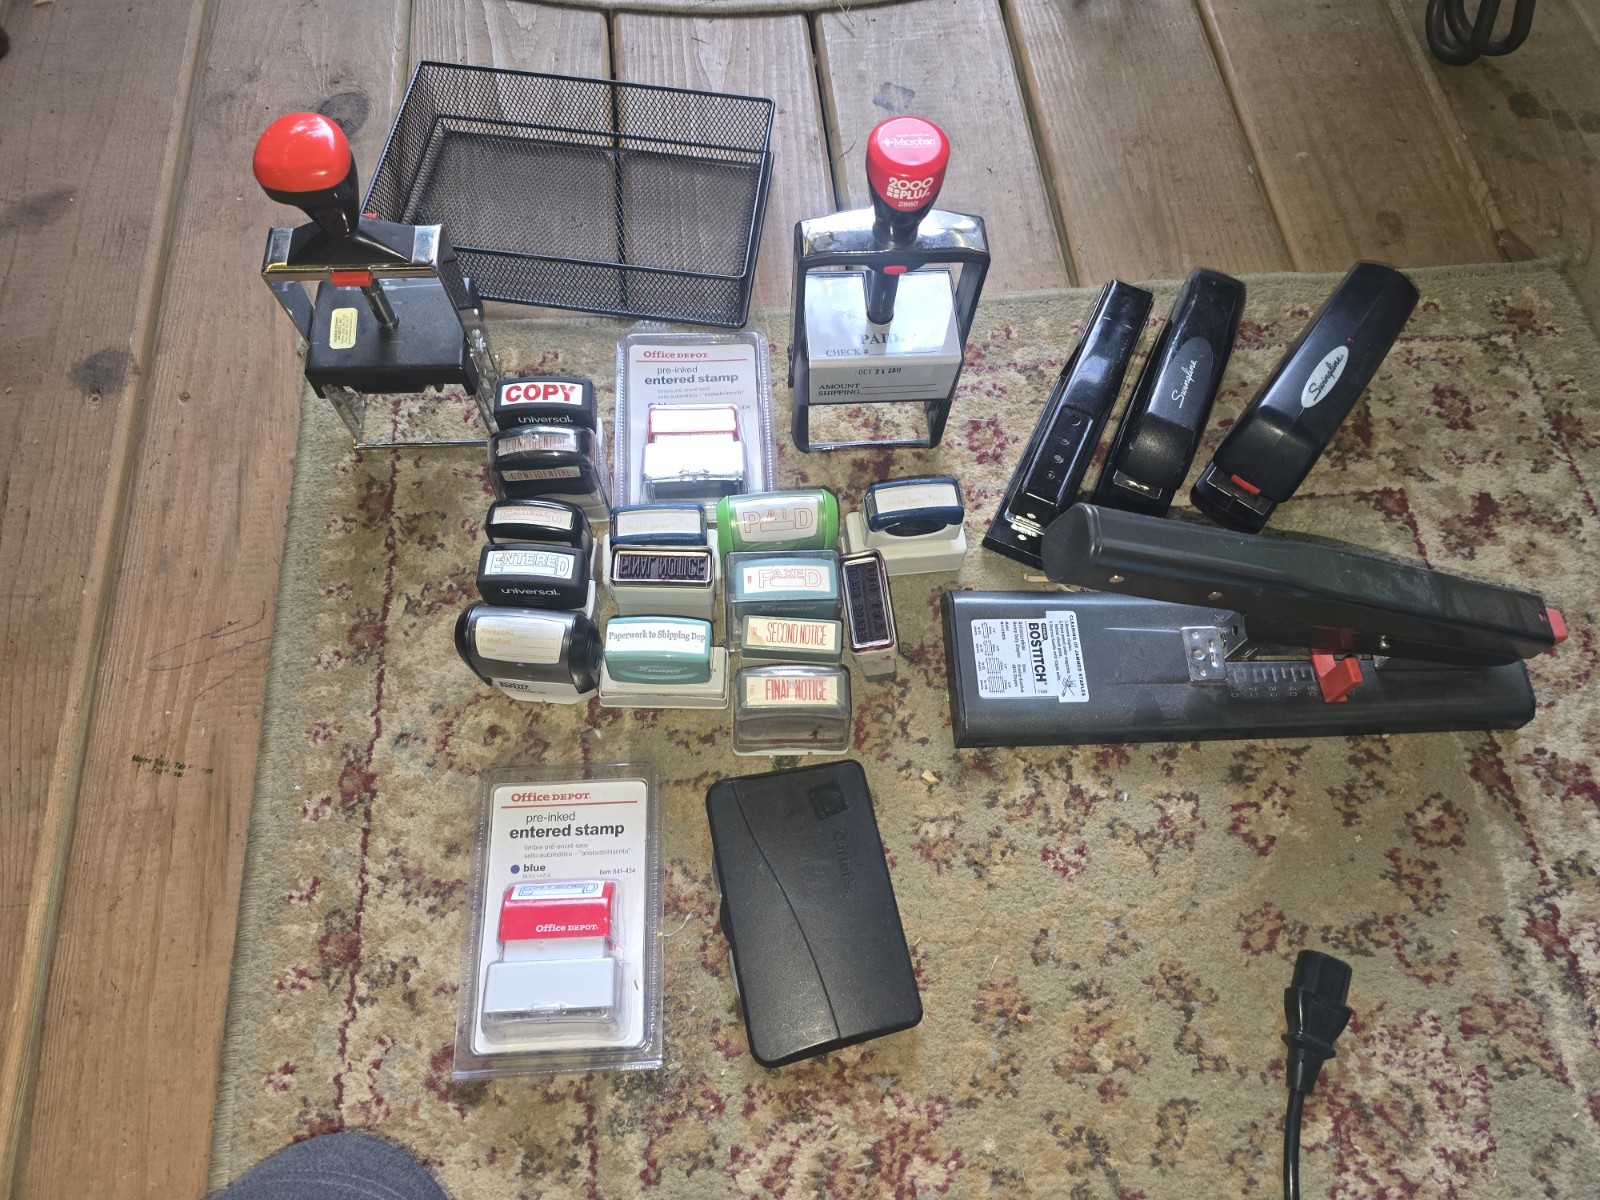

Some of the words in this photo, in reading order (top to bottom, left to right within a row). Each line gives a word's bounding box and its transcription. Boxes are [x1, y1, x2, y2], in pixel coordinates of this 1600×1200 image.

[893, 137, 936, 147] Microban
[888, 177, 934, 191] 2000
[899, 187, 929, 200] PLUS
[898, 200, 919, 208] 2860
[860, 333, 899, 345] PAID
[643, 350, 676, 359] Office
[826, 349, 860, 357] CHECK
[657, 366, 698, 375] pre-inked
[644, 375, 695, 385] entered
[698, 373, 739, 384] stamp
[1171, 359, 1198, 409] Swingline
[1308, 355, 1343, 401] Swingline
[505, 384, 576, 402] COPY
[518, 415, 571, 424] universal
[510, 470, 571, 480] CONFIDENTIAL
[742, 507, 814, 534] PAID
[490, 552, 570, 577] ENTERED
[758, 568, 822, 588] FAXED
[501, 588, 560, 596] universal
[608, 628, 648, 641] Paperwork
[648, 630, 656, 639] to
[657, 629, 690, 642] Shipping
[766, 621, 799, 644] SECOND
[800, 624, 827, 646] NOTICE
[1028, 622, 1047, 682] BOSTITCH
[794, 679, 827, 701] NOTICE
[511, 792, 550, 803] Office
[551, 792, 590, 801] DEPOT
[526, 811, 576, 825] pre-inked
[509, 824, 572, 839] entered
[575, 823, 625, 837] stamp
[539, 850, 573, 858] automático
[523, 863, 546, 873] blue
[612, 867, 636, 875] 841-434
[535, 923, 566, 933] Office
[567, 923, 598, 932] DEPOT
